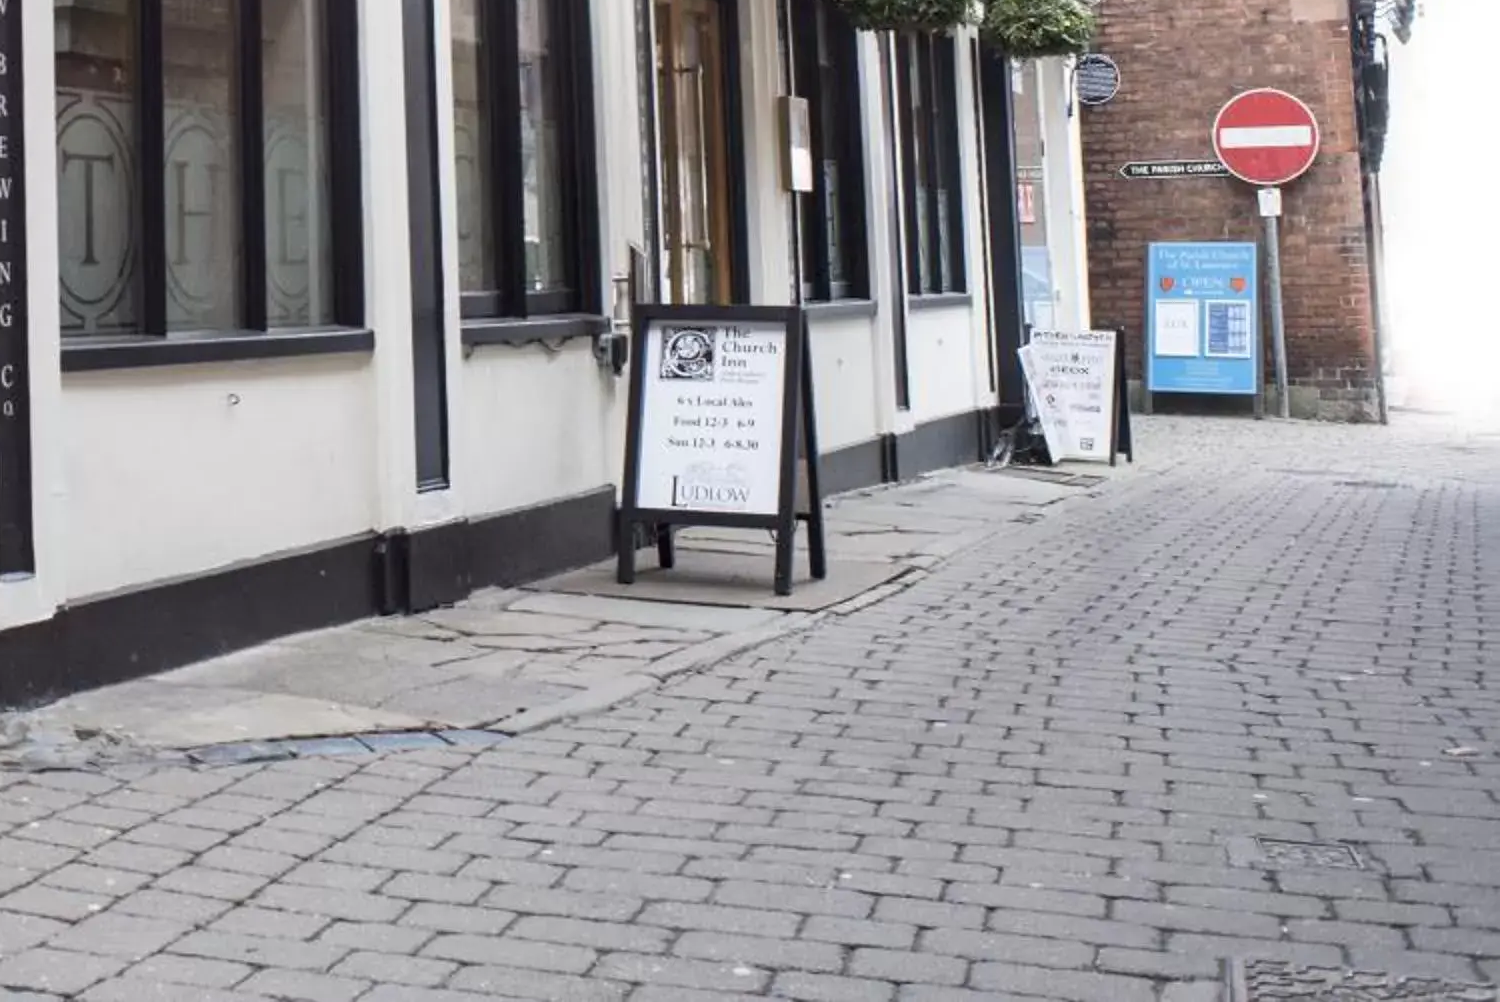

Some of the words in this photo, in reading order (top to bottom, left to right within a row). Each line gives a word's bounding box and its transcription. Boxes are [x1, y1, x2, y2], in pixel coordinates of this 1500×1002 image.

[1130, 166, 1150, 175] THE
[1151, 165, 1185, 174] PARISH
[721, 325, 752, 339] The
[721, 341, 778, 355] Church
[721, 355, 748, 368] Inn
[697, 396, 727, 407] Local
